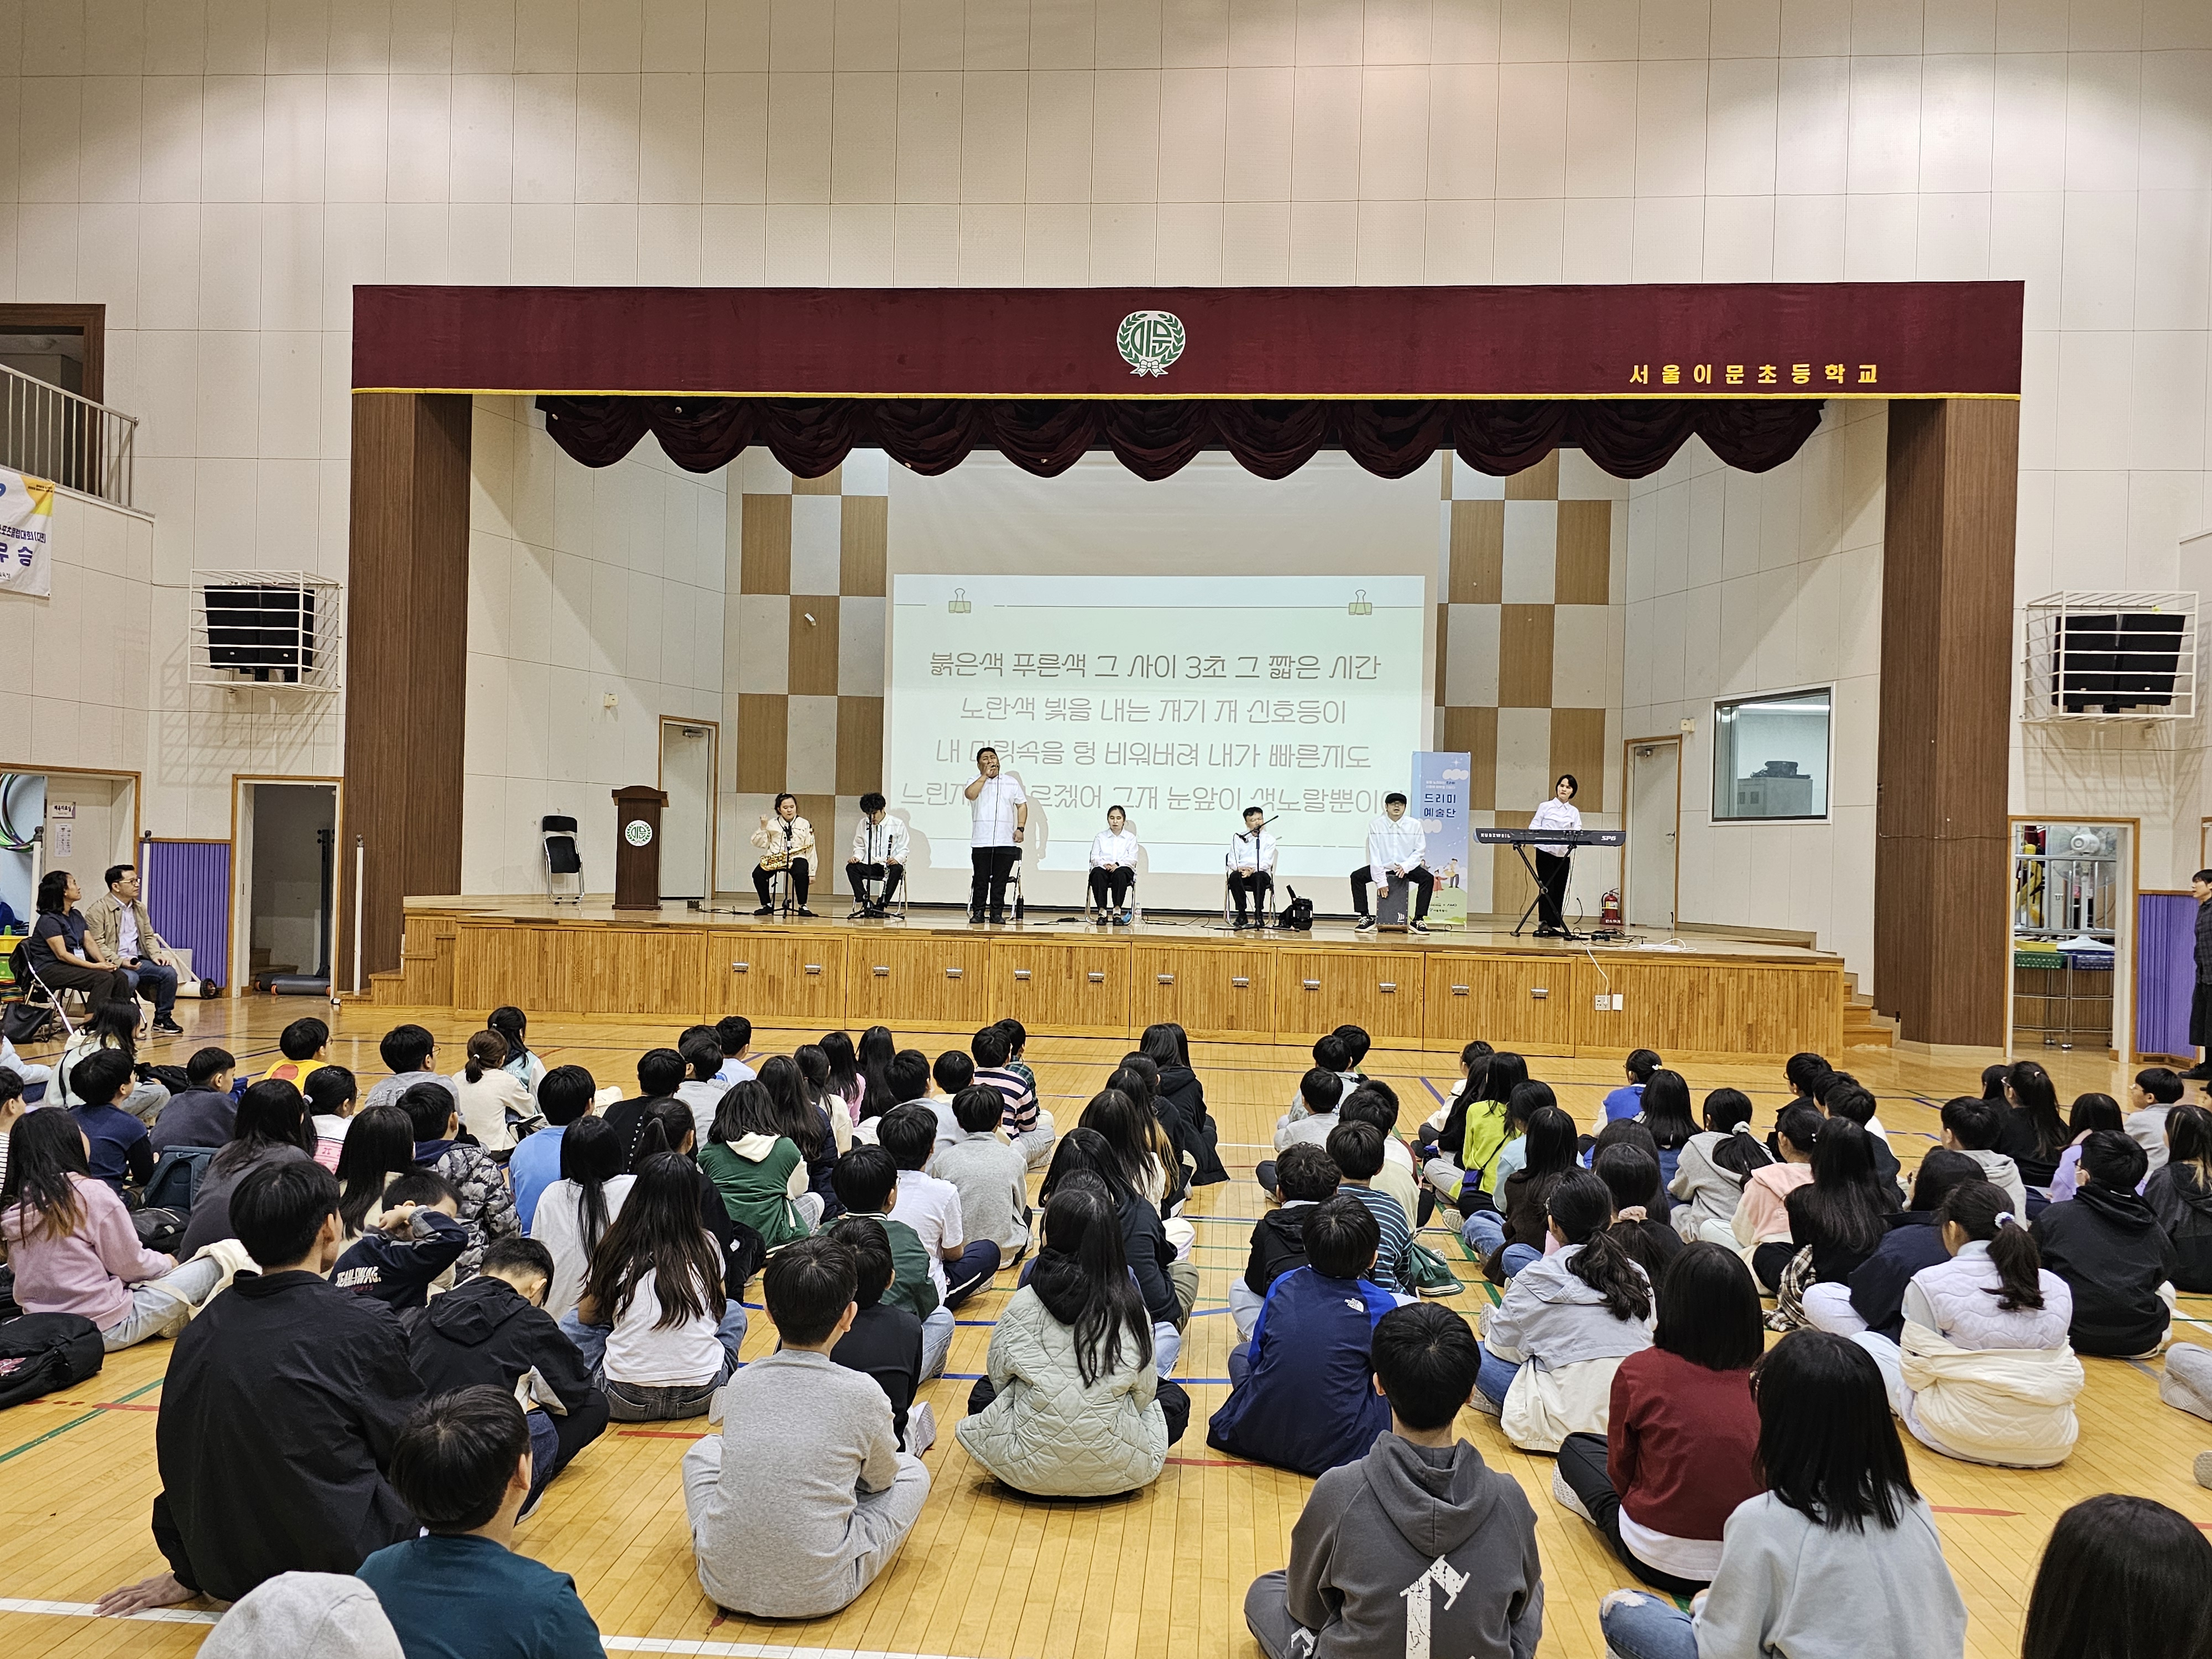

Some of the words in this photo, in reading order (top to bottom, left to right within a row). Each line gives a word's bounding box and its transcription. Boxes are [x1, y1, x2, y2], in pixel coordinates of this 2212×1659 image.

[1629, 363, 1877, 384] 서울이문초등학교
[930, 652, 1003, 677] 붉은색
[1012, 653, 1086, 677] 푸른색
[1095, 655, 1119, 677] 그
[1127, 654, 1176, 679] 사이
[1185, 655, 1227, 679] 3초
[1235, 656, 1260, 678] 그
[1269, 655, 1321, 679] 짧은
[1328, 655, 1381, 680] 시간
[960, 697, 1035, 721] 노란색
[1045, 697, 1092, 721] 빛을
[1100, 698, 1150, 722] 내는
[1246, 699, 1345, 724] 신호등이
[936, 739, 959, 763] 내
[1073, 742, 1095, 765] 텅
[1105, 742, 1198, 766] 비워버려
[1208, 743, 1261, 768] 내가
[1269, 744, 1371, 769] 빠른지도
[1031, 785, 1102, 808] 르겠어
[1167, 786, 1240, 811] 눈앞이
[1424, 794, 1456, 804] 드리미
[1424, 807, 1457, 818] 예술단
